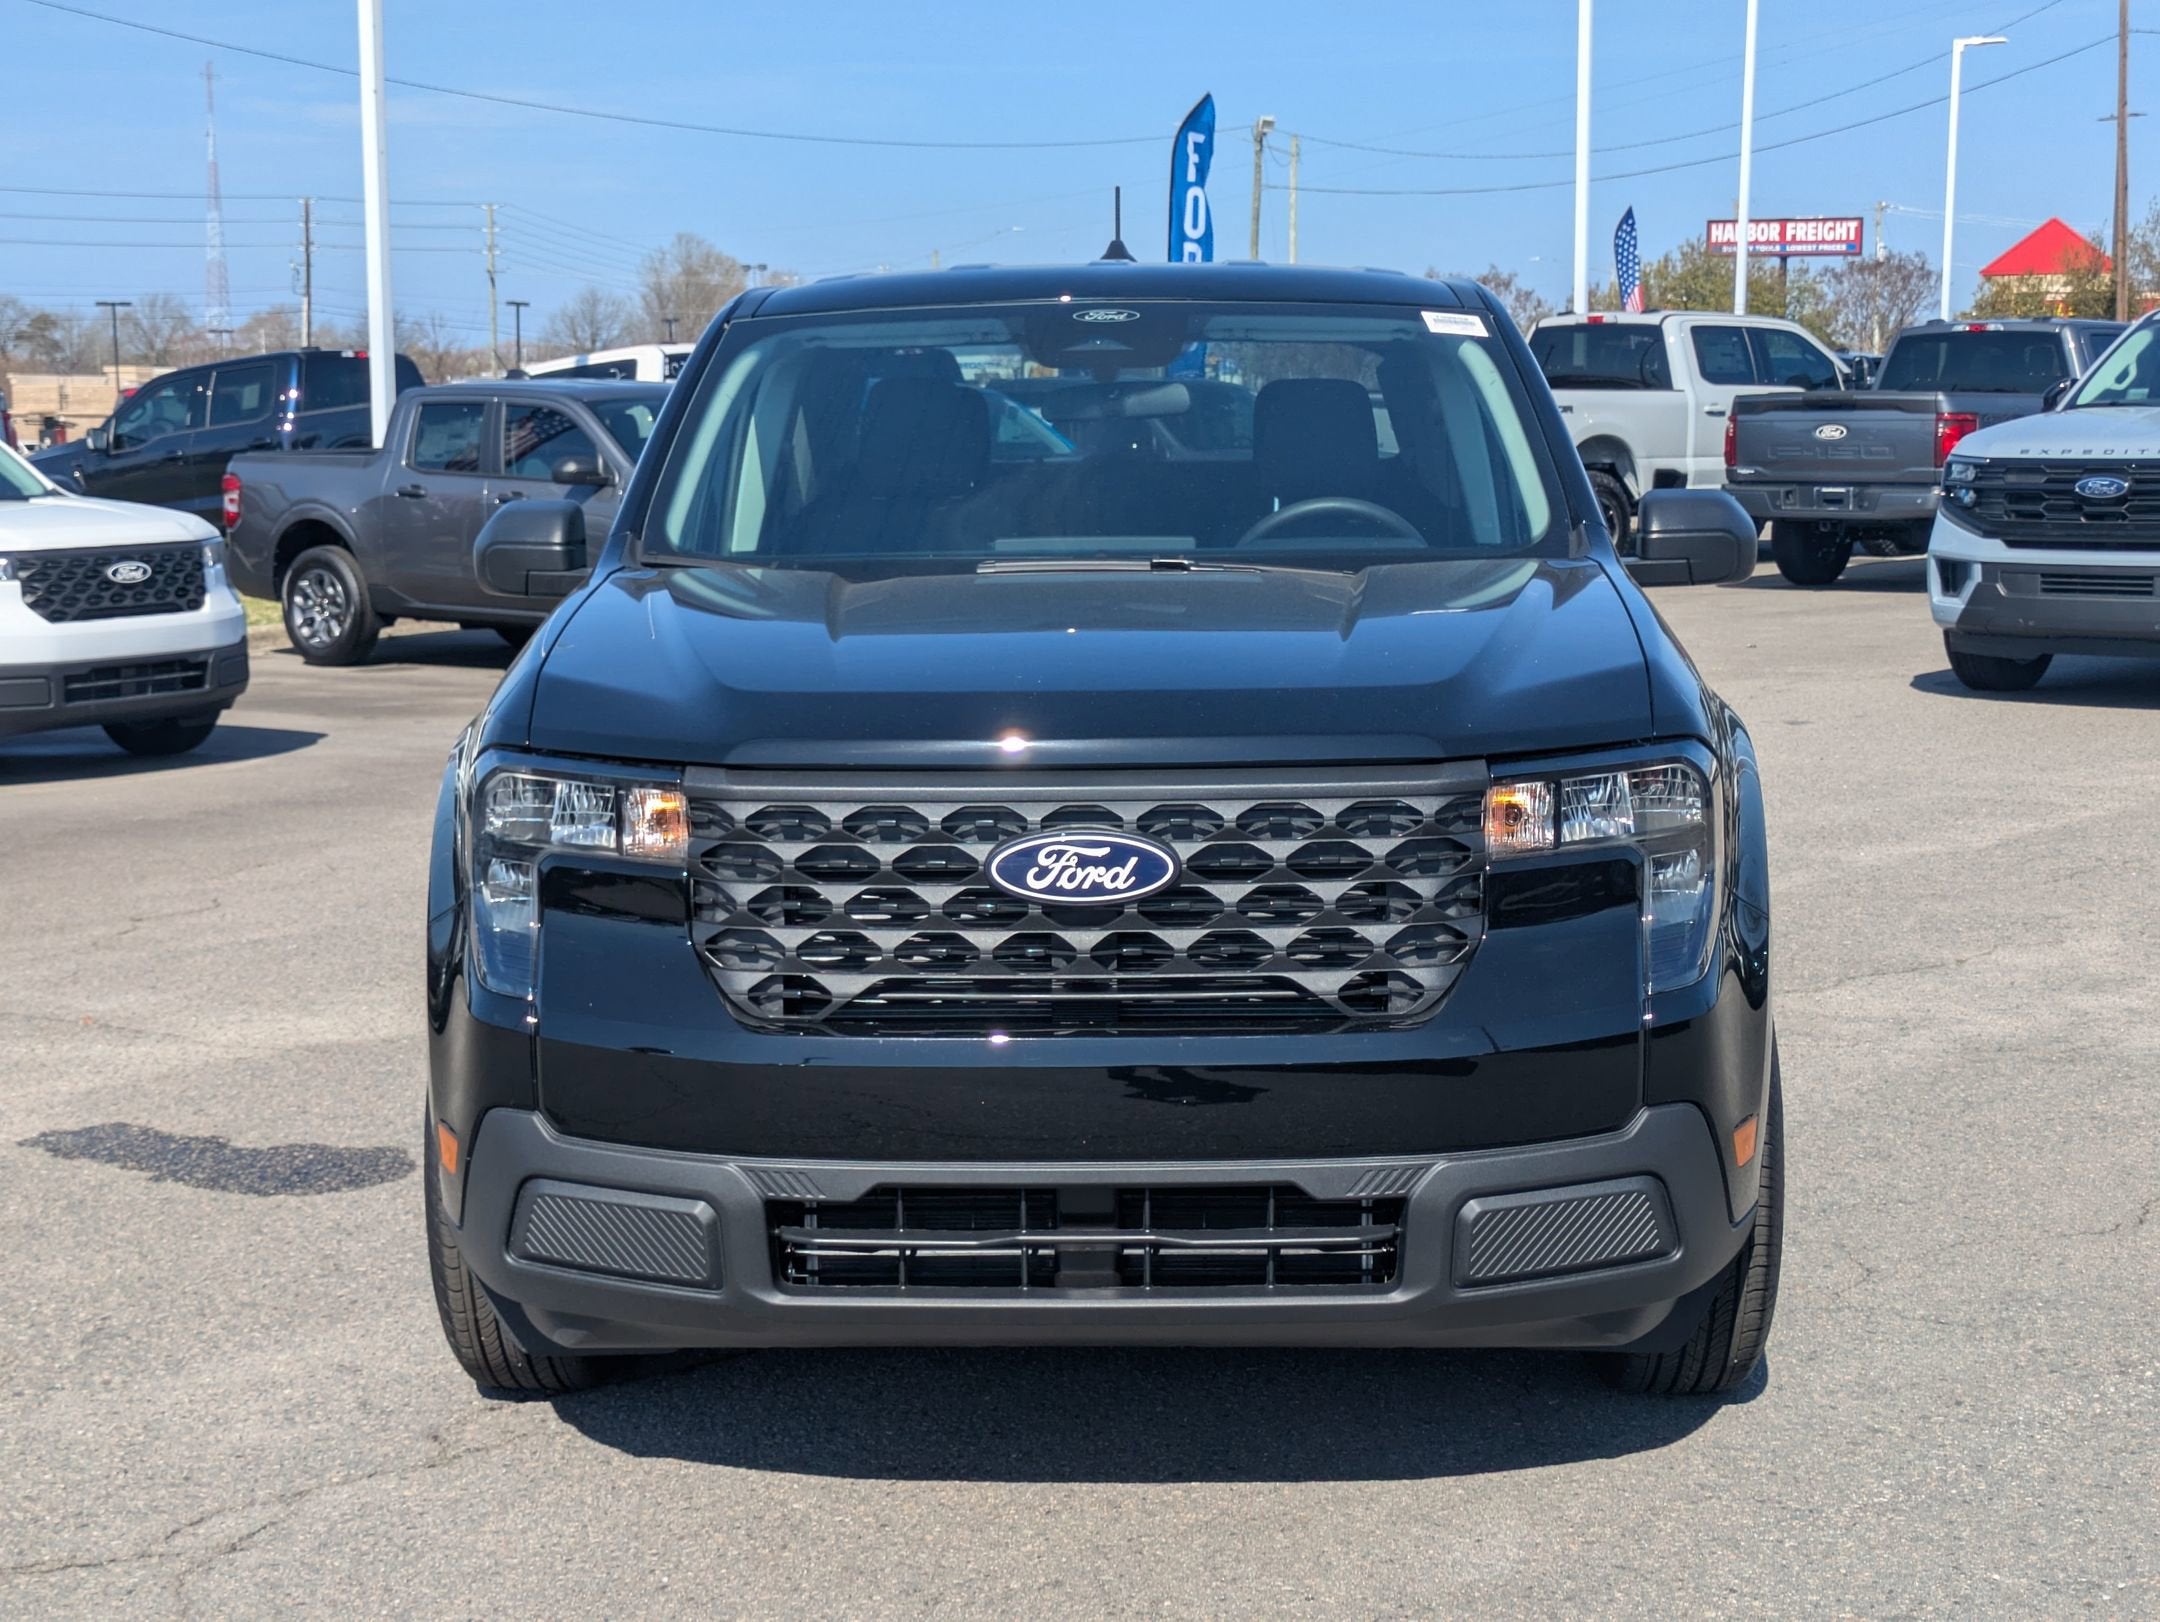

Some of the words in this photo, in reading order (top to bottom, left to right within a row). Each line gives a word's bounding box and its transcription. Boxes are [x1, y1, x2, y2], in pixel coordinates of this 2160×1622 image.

[1711, 222, 1780, 243] HABOR
[1785, 220, 1858, 241] FREIGHT
[1084, 310, 1129, 321] Ford
[1767, 443, 1896, 460] F-150
[2085, 480, 2118, 494] Ford
[1026, 844, 1139, 890] Ford
